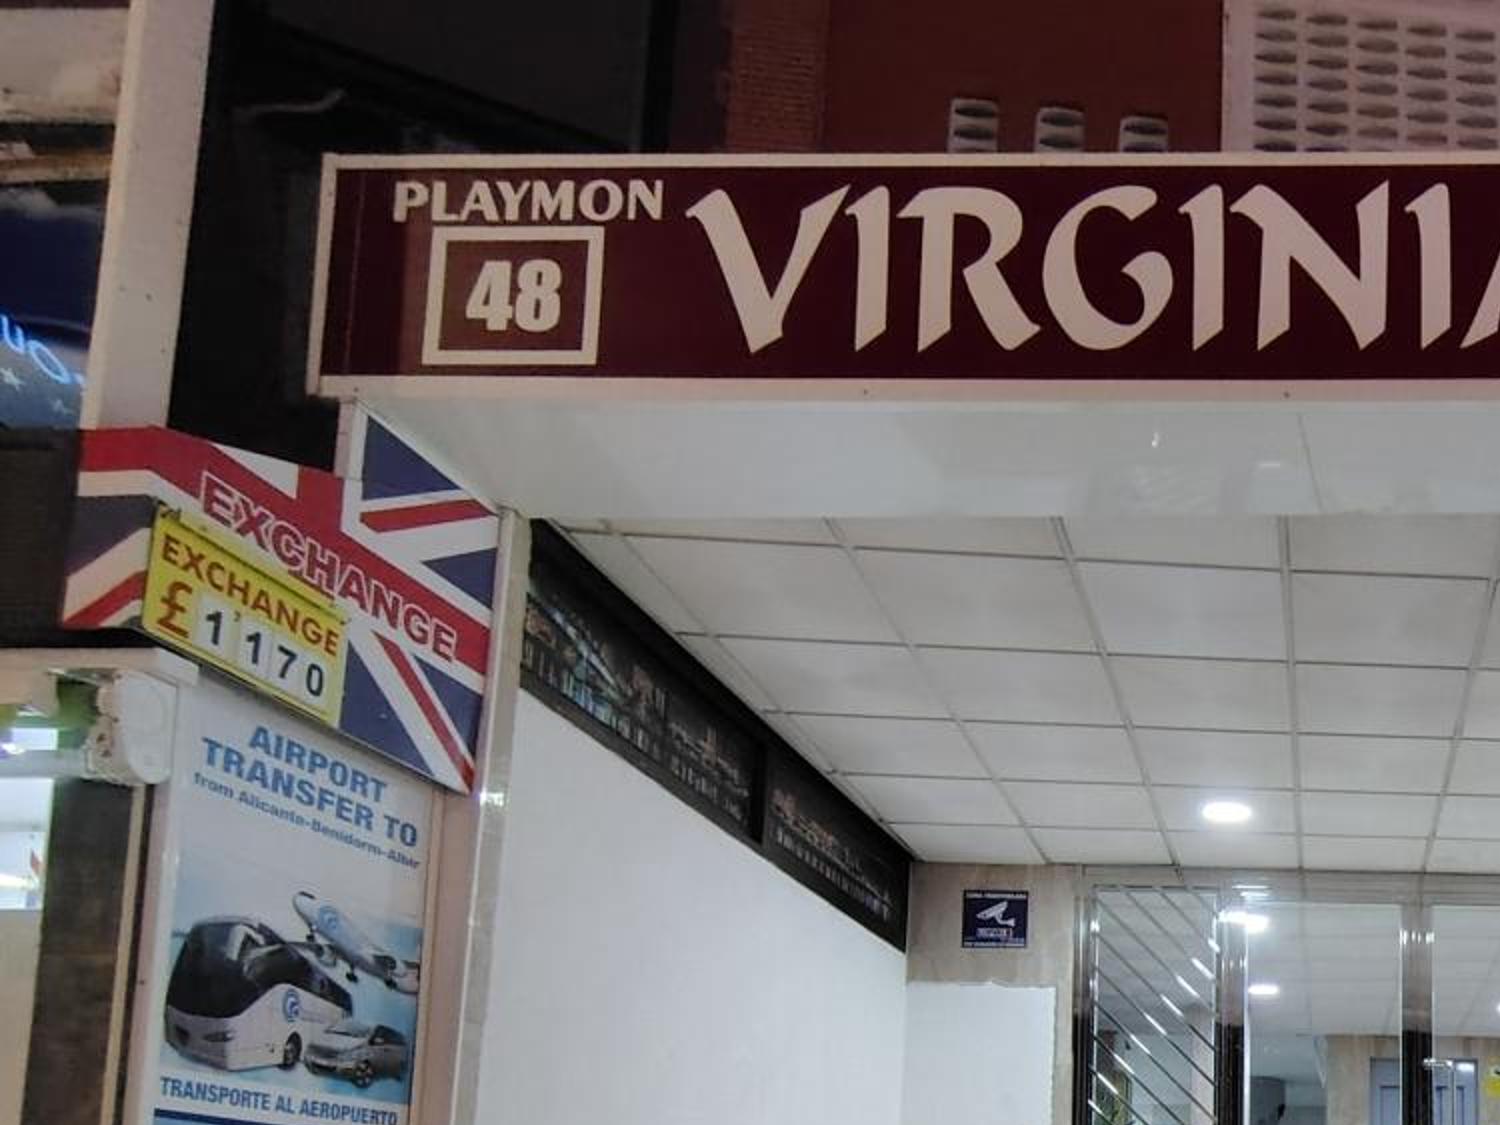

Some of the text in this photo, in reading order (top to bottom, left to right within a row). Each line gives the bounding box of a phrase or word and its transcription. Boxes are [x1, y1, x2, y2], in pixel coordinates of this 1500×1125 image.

[393, 180, 664, 223] PLAYMON
[465, 260, 562, 332] 48
[161, 534, 340, 657] EXCHANGE
[202, 471, 457, 662] EXCHANGE
[194, 771, 234, 799] from
[202, 737, 417, 847] TRANSFER TO
[250, 725, 387, 802] AIRPORT
[160, 1076, 271, 1111] TRANSPORTE
[275, 1096, 296, 1115] AL
